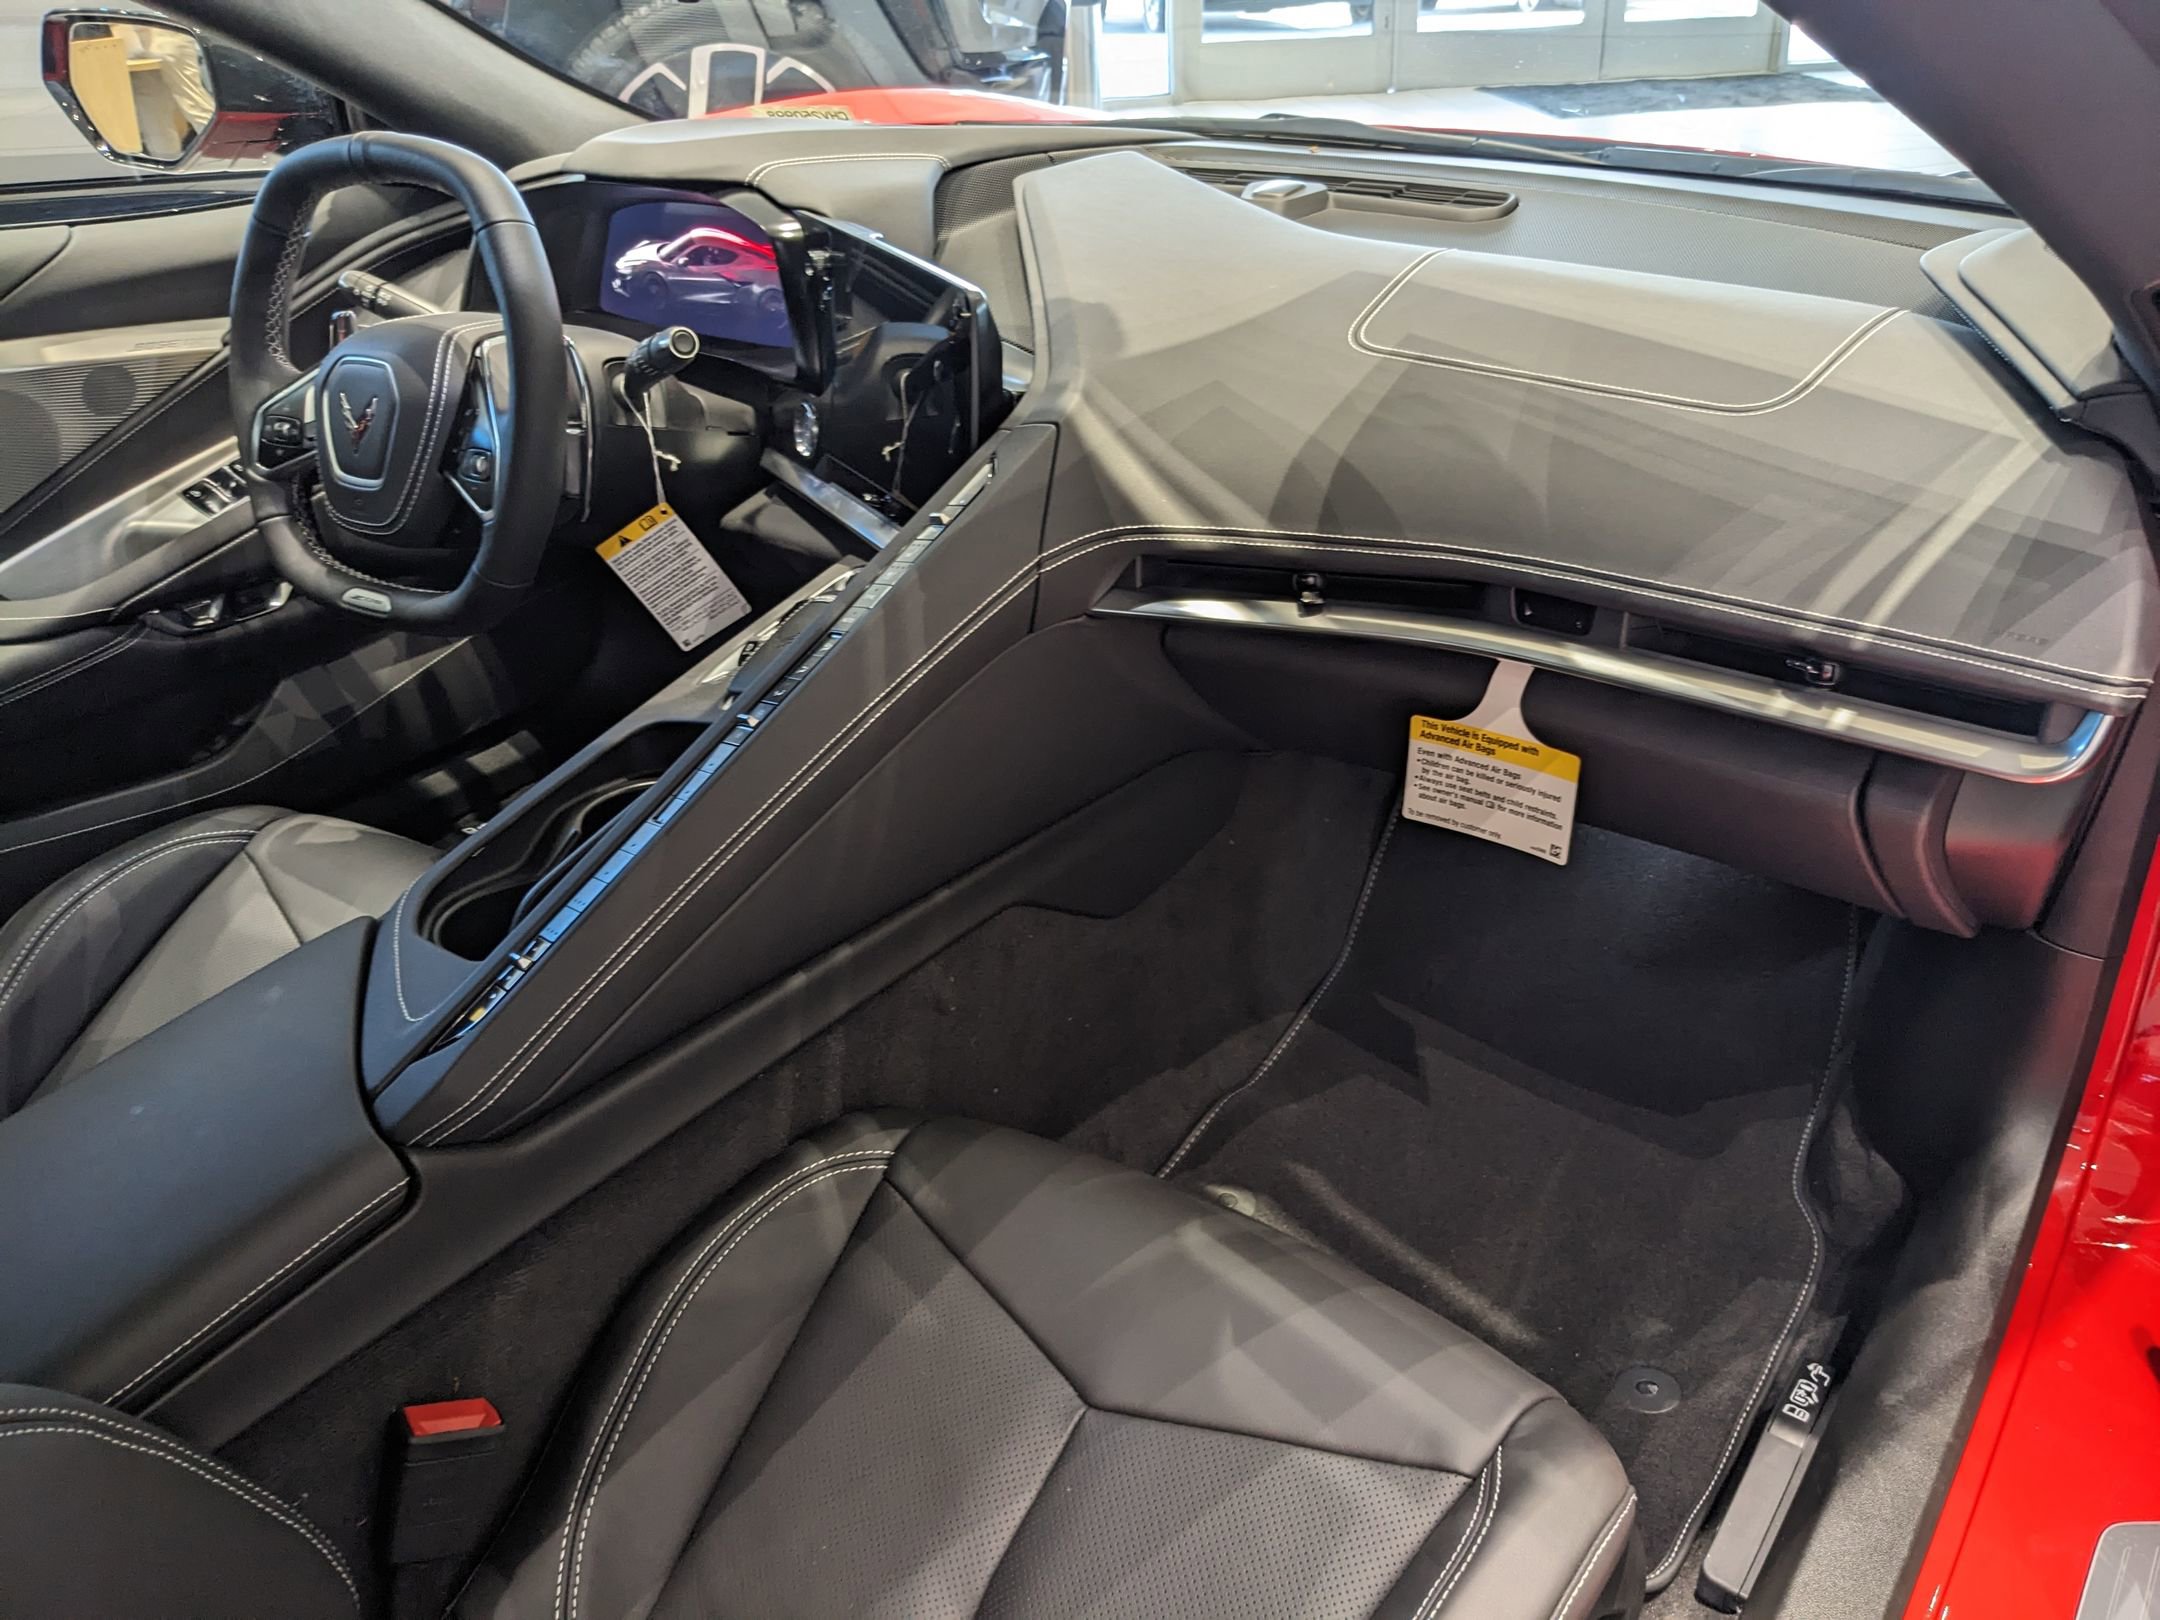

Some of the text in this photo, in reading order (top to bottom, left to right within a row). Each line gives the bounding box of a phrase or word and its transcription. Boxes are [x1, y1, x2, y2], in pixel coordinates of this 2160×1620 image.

[1420, 730, 1496, 756] Advanced Air Bags
[1422, 719, 1539, 756] This Vehicle is Equipped with
[1417, 747, 1521, 780] Even with Advanced Air Bags
[1422, 767, 1430, 775] by
[1432, 769, 1443, 777] the
[1456, 775, 1470, 785] bag.
[1421, 758, 1450, 770] Children
[1451, 766, 1464, 774] can
[1476, 772, 1495, 782] killed
[1505, 781, 1536, 796] seriously
[1538, 790, 1561, 803] injured
[1418, 793, 1437, 802] about
[1449, 800, 1467, 809] bags.
[1418, 783, 1562, 831] See owner's manual for more information
[1419, 775, 1443, 786] Always
[1459, 785, 1473, 794] seat
[1475, 789, 1491, 799] belts
[1492, 795, 1506, 803] and
[1506, 799, 1523, 809] child
[1524, 804, 1557, 820] restraints.
[1408, 807, 1415, 815] To
[1425, 813, 1451, 824] removed
[1452, 819, 1459, 827] by
[1460, 822, 1488, 834] customer
